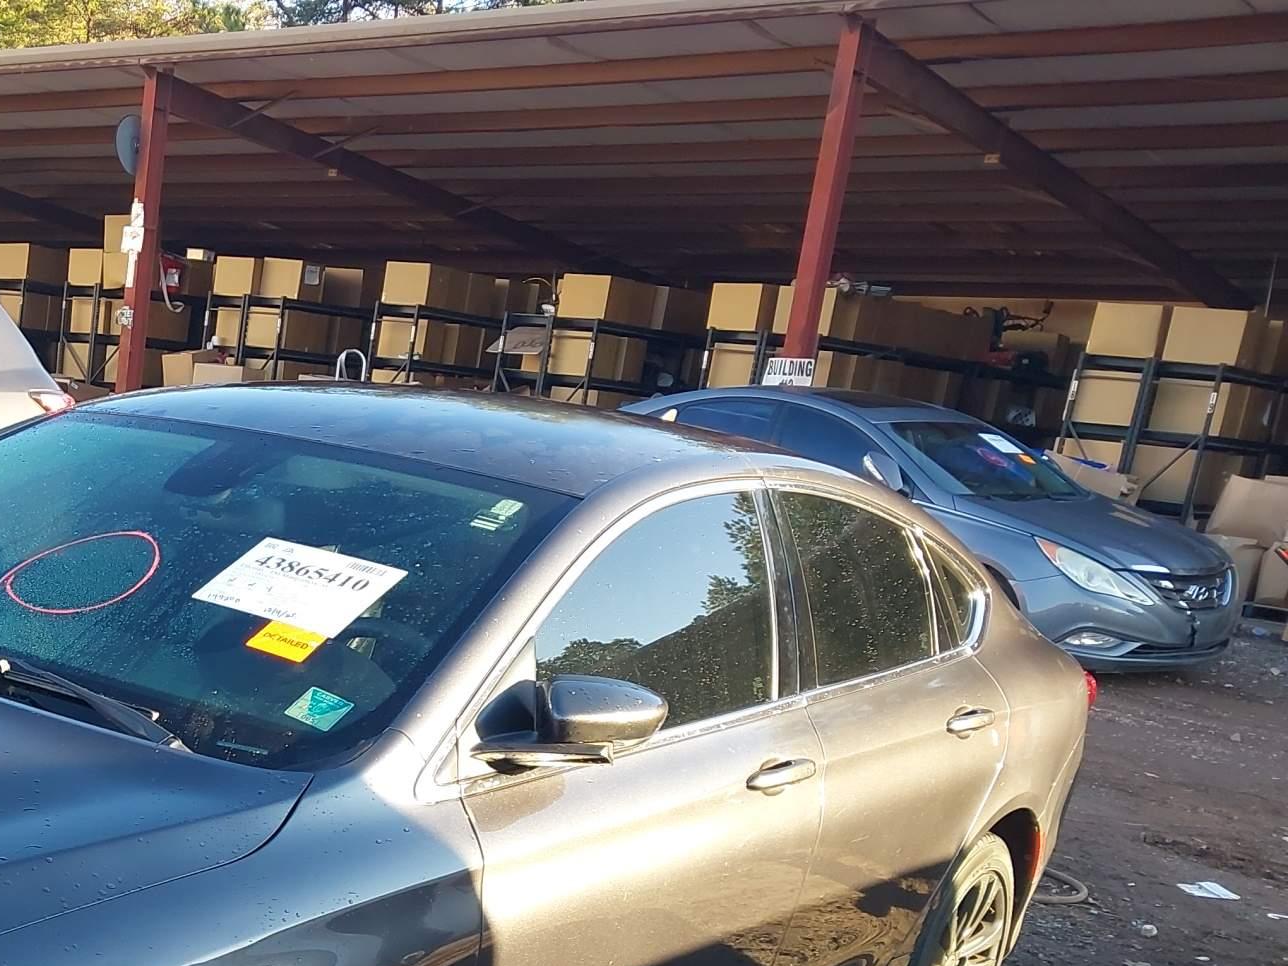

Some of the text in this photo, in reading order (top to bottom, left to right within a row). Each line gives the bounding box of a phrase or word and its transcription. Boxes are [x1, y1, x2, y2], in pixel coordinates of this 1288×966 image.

[767, 359, 812, 377] BUILDING
[254, 554, 370, 593] 43865410
[262, 631, 309, 650] DETAILED
